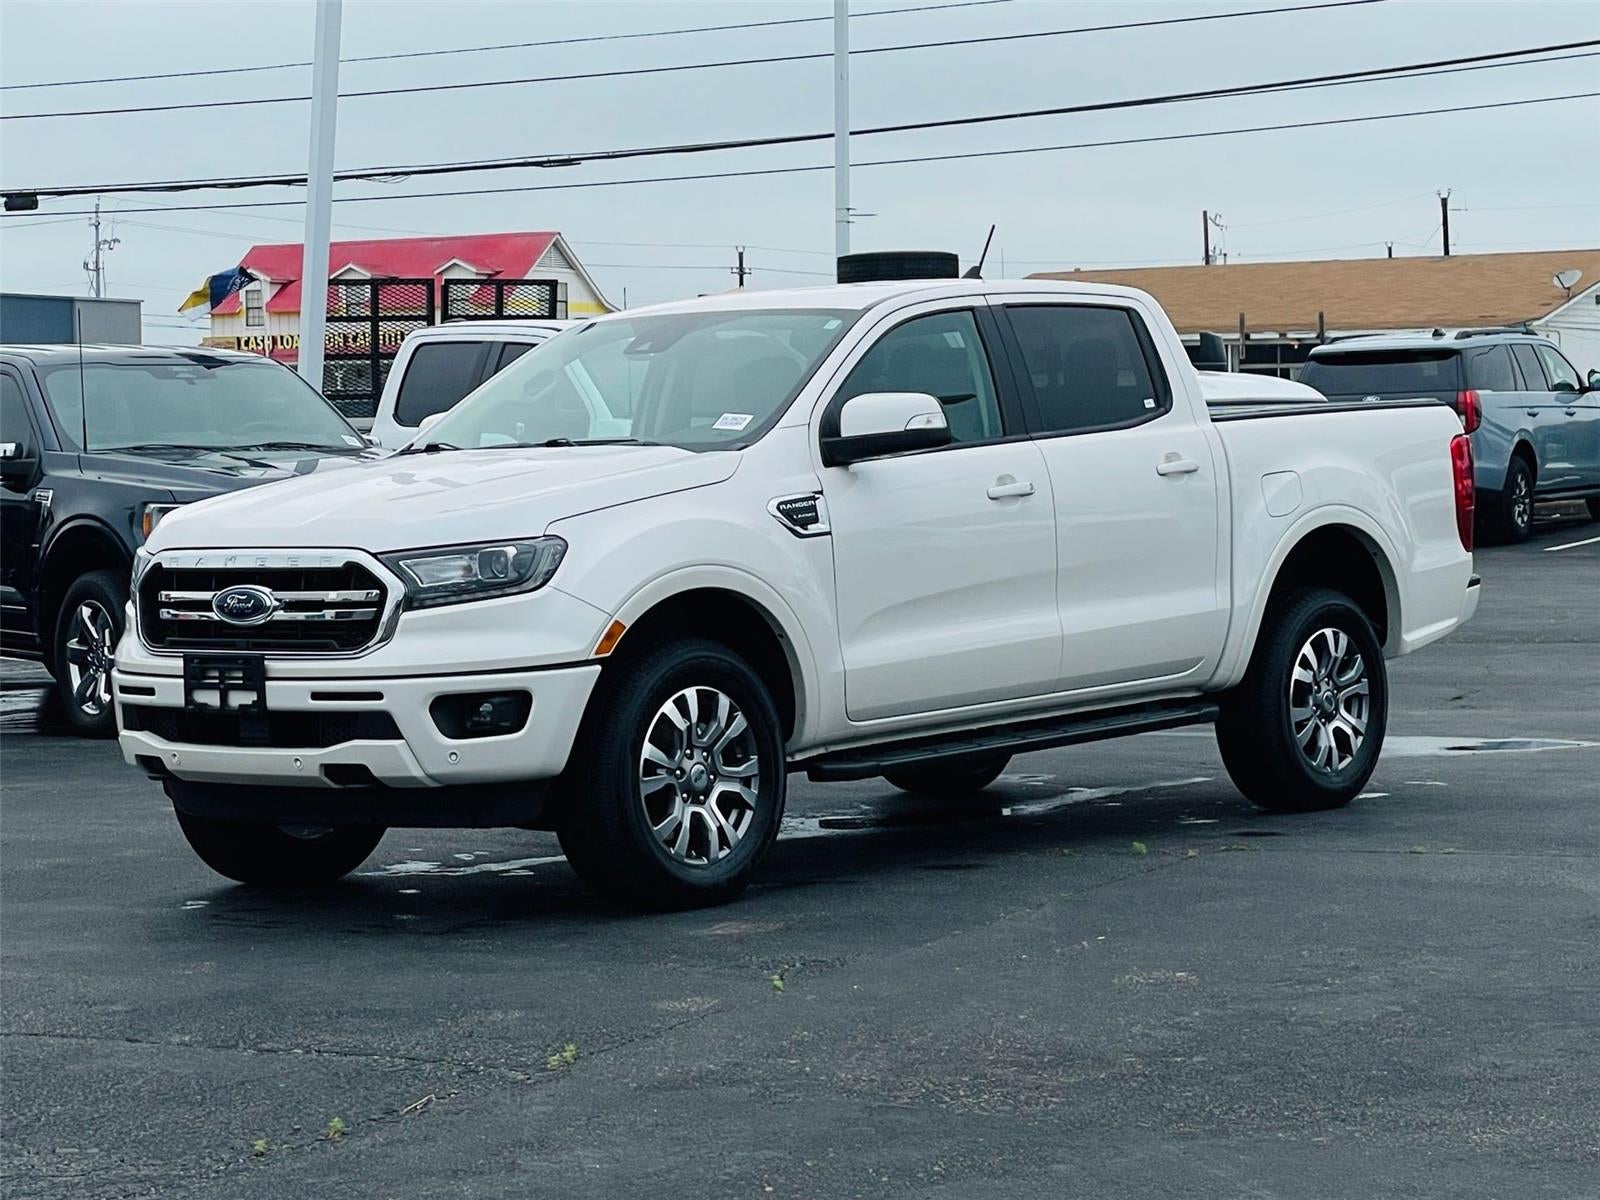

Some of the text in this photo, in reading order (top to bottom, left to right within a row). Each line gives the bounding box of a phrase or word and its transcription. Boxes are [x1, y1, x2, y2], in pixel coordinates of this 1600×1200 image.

[240, 336, 272, 350] CASH
[277, 335, 299, 349] LOA
[779, 500, 816, 509] RANGER
[168, 556, 333, 567] RANGER
[224, 594, 254, 608] Ford
